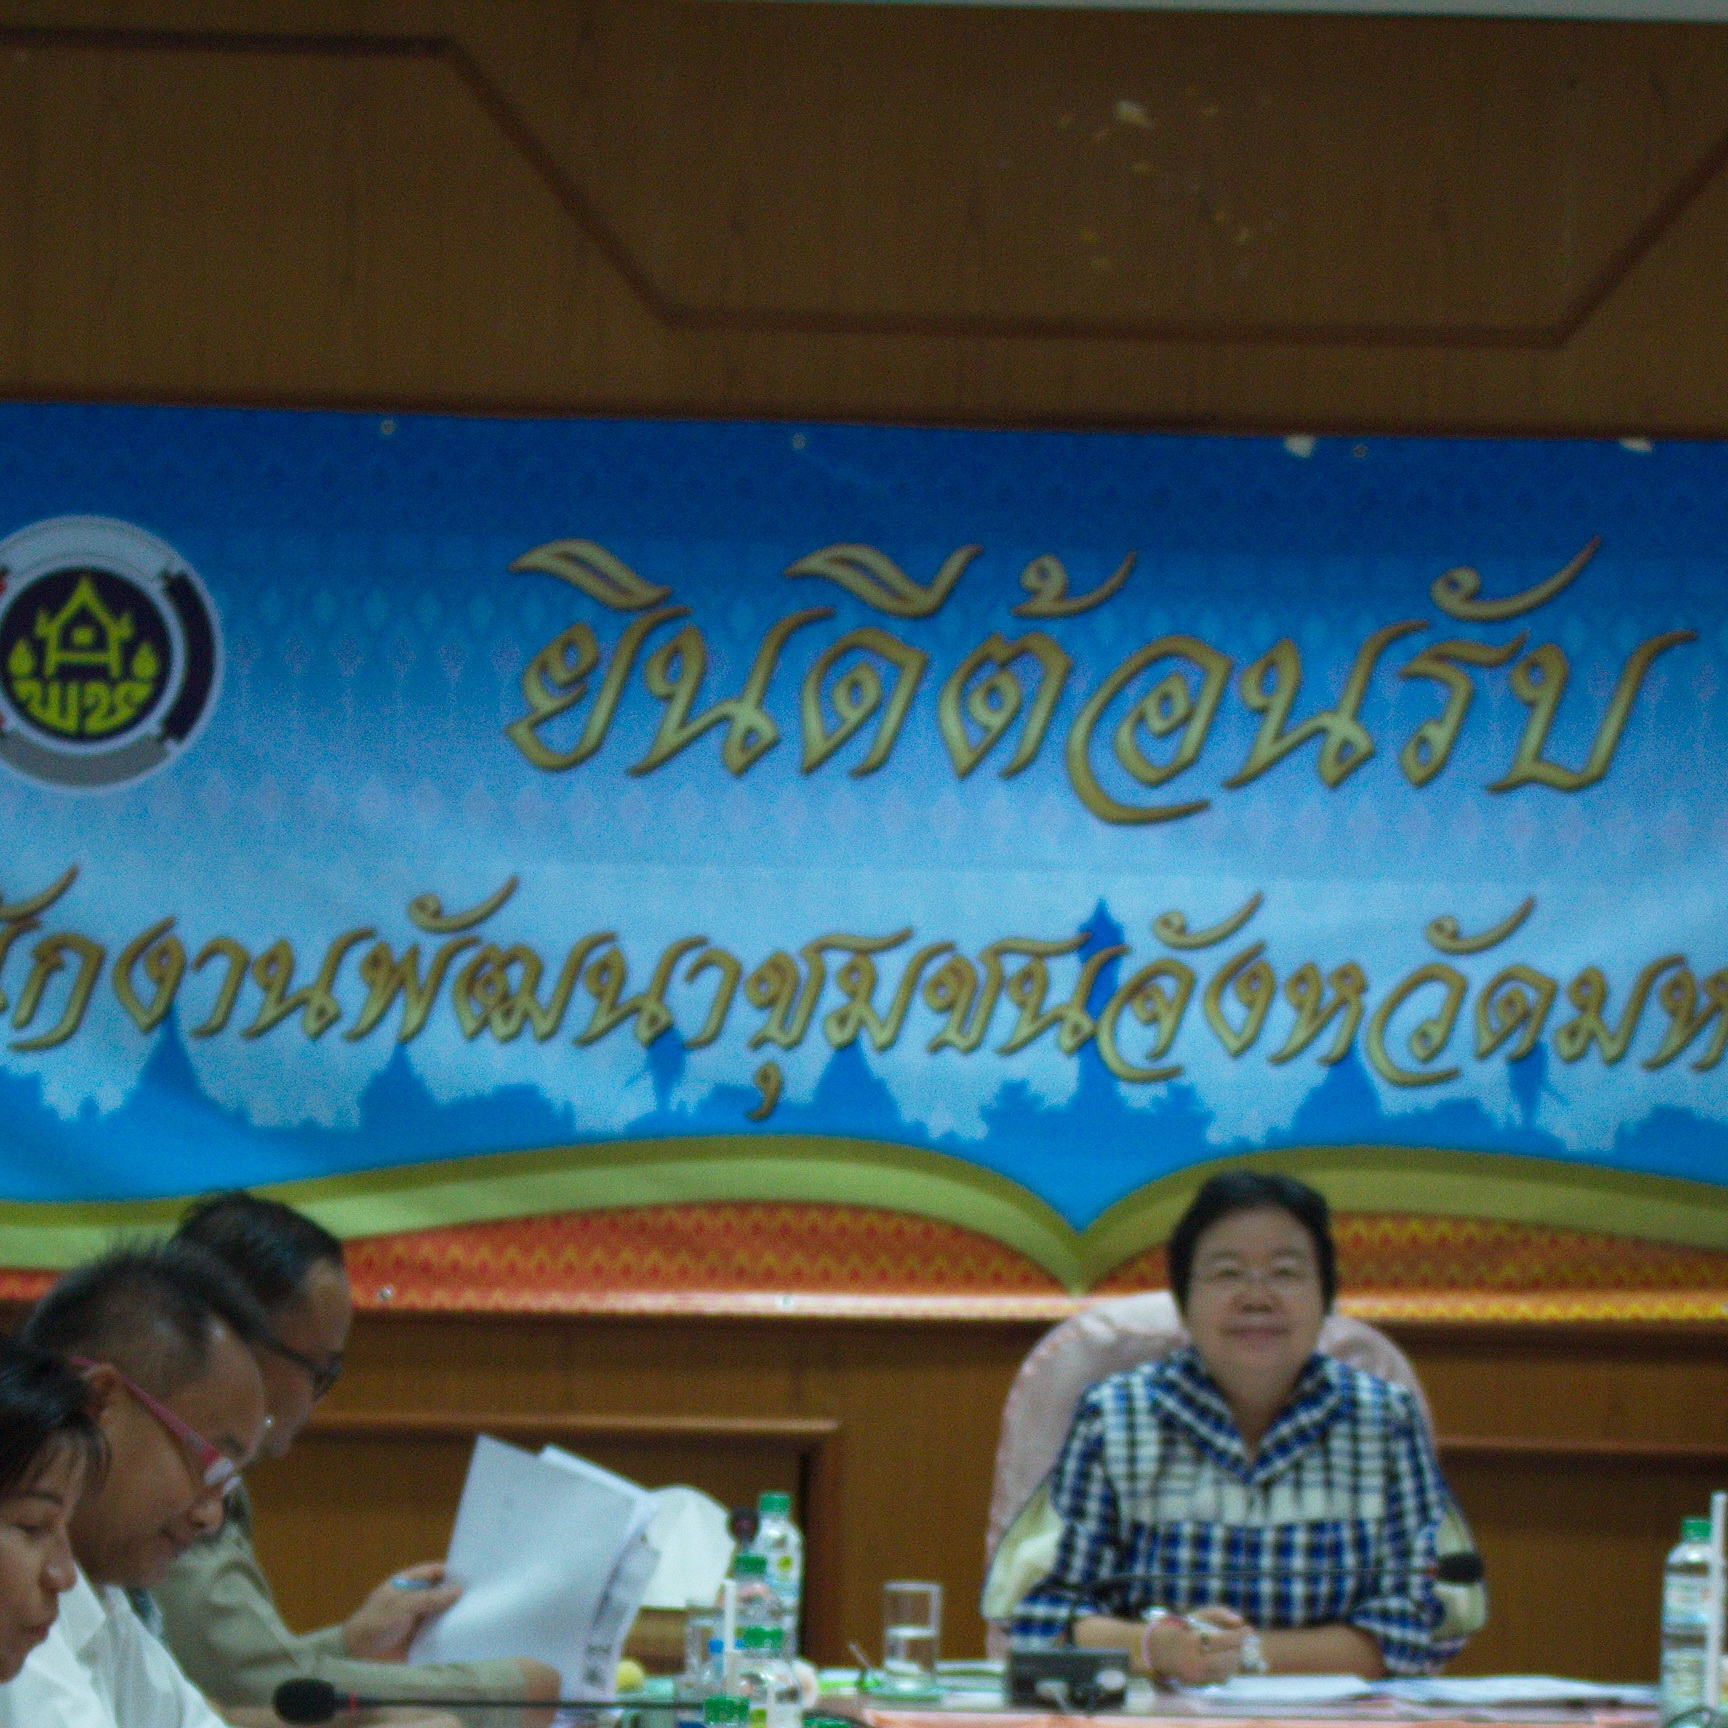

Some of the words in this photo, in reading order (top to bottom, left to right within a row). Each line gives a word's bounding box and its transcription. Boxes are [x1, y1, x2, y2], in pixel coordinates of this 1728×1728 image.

[504, 535, 1698, 825] ยินดีต้อนรับ
